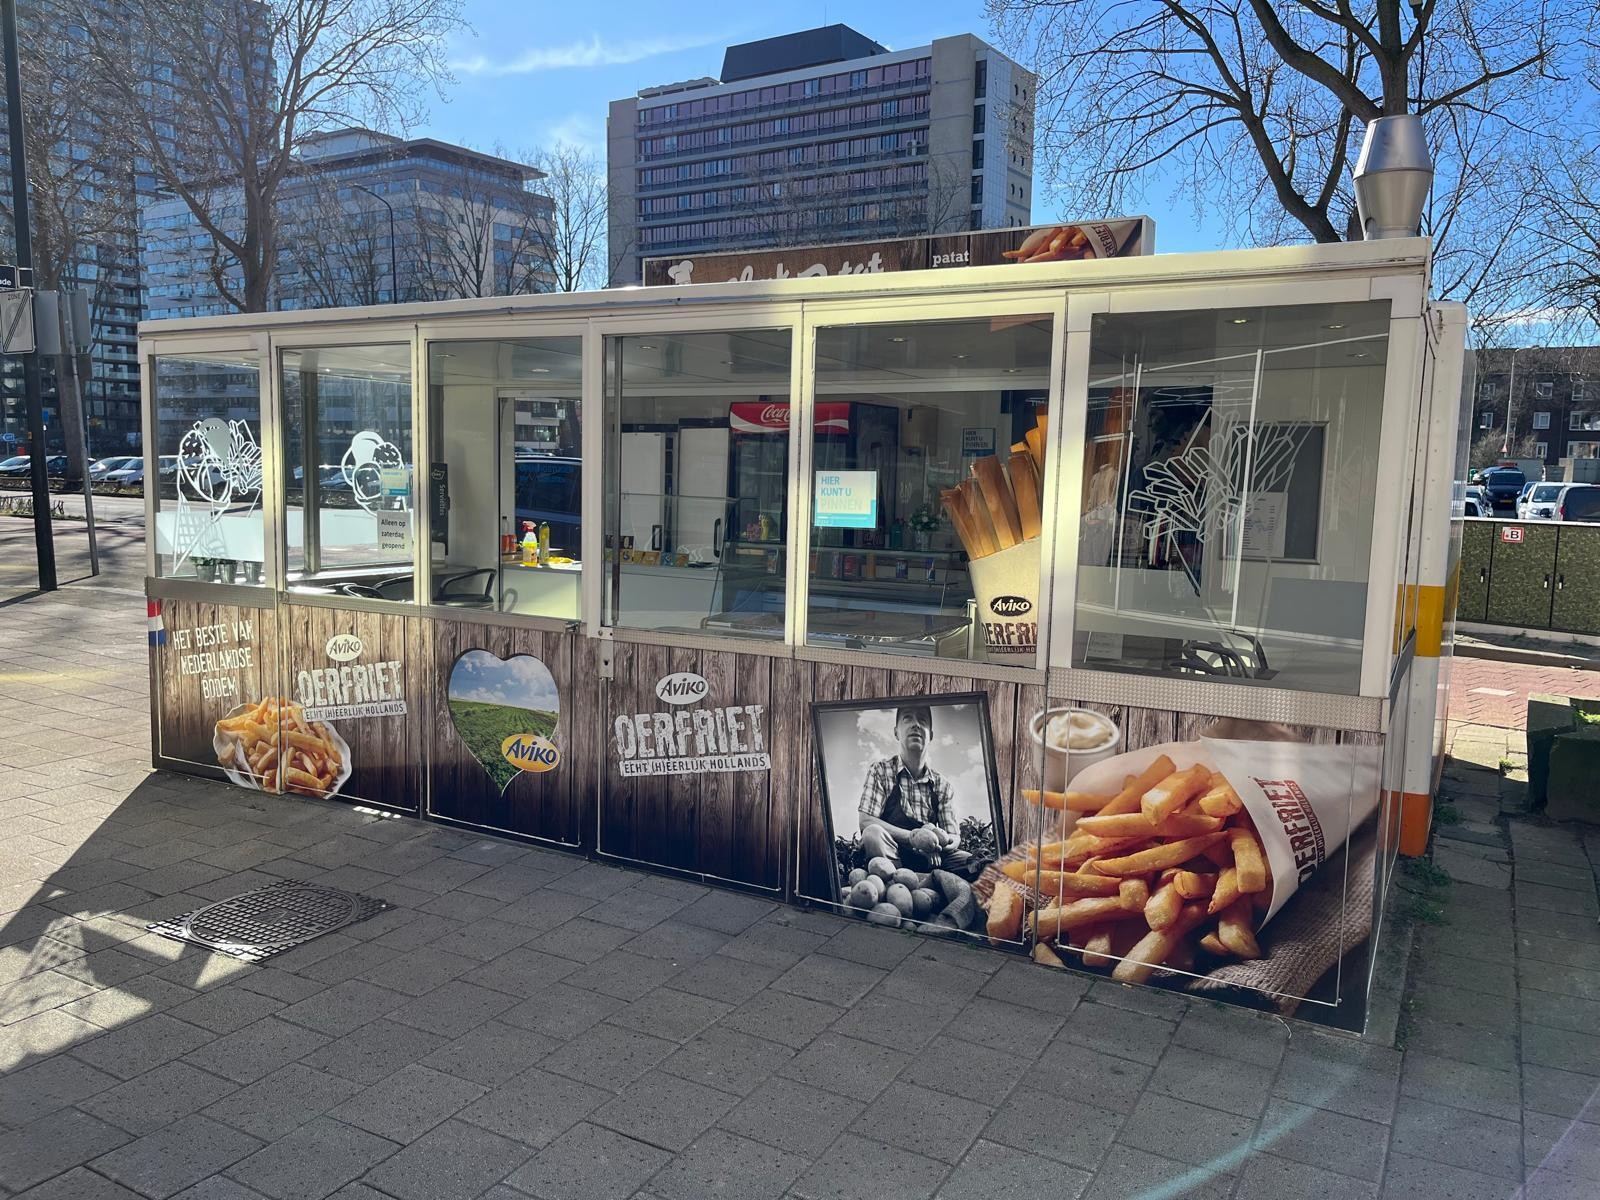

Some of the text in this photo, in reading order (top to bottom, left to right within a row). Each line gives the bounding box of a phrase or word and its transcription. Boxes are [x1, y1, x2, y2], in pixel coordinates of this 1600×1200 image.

[932, 250, 970, 268] patat
[821, 475, 840, 485] HIER
[821, 487, 852, 497] KUNT U
[381, 519, 398, 527] Alleen
[381, 531, 405, 540] zaterdag
[1510, 530, 1519, 539] B
[992, 598, 1030, 611] Aviko
[172, 619, 255, 651] HET BESTE VAN
[329, 638, 361, 655] Aviko
[180, 646, 254, 675] NEDERLANDSE
[202, 676, 239, 699] BODEM
[297, 660, 403, 708] OERFRIET
[659, 677, 706, 698] Aviko
[306, 710, 323, 720] ECHT
[365, 703, 404, 715] HOLLANDS
[614, 704, 765, 759] OERFRIET
[505, 737, 557, 766] Aviko
[624, 756, 766, 774] ECHT (H)EERLIJK HOLLANDS
